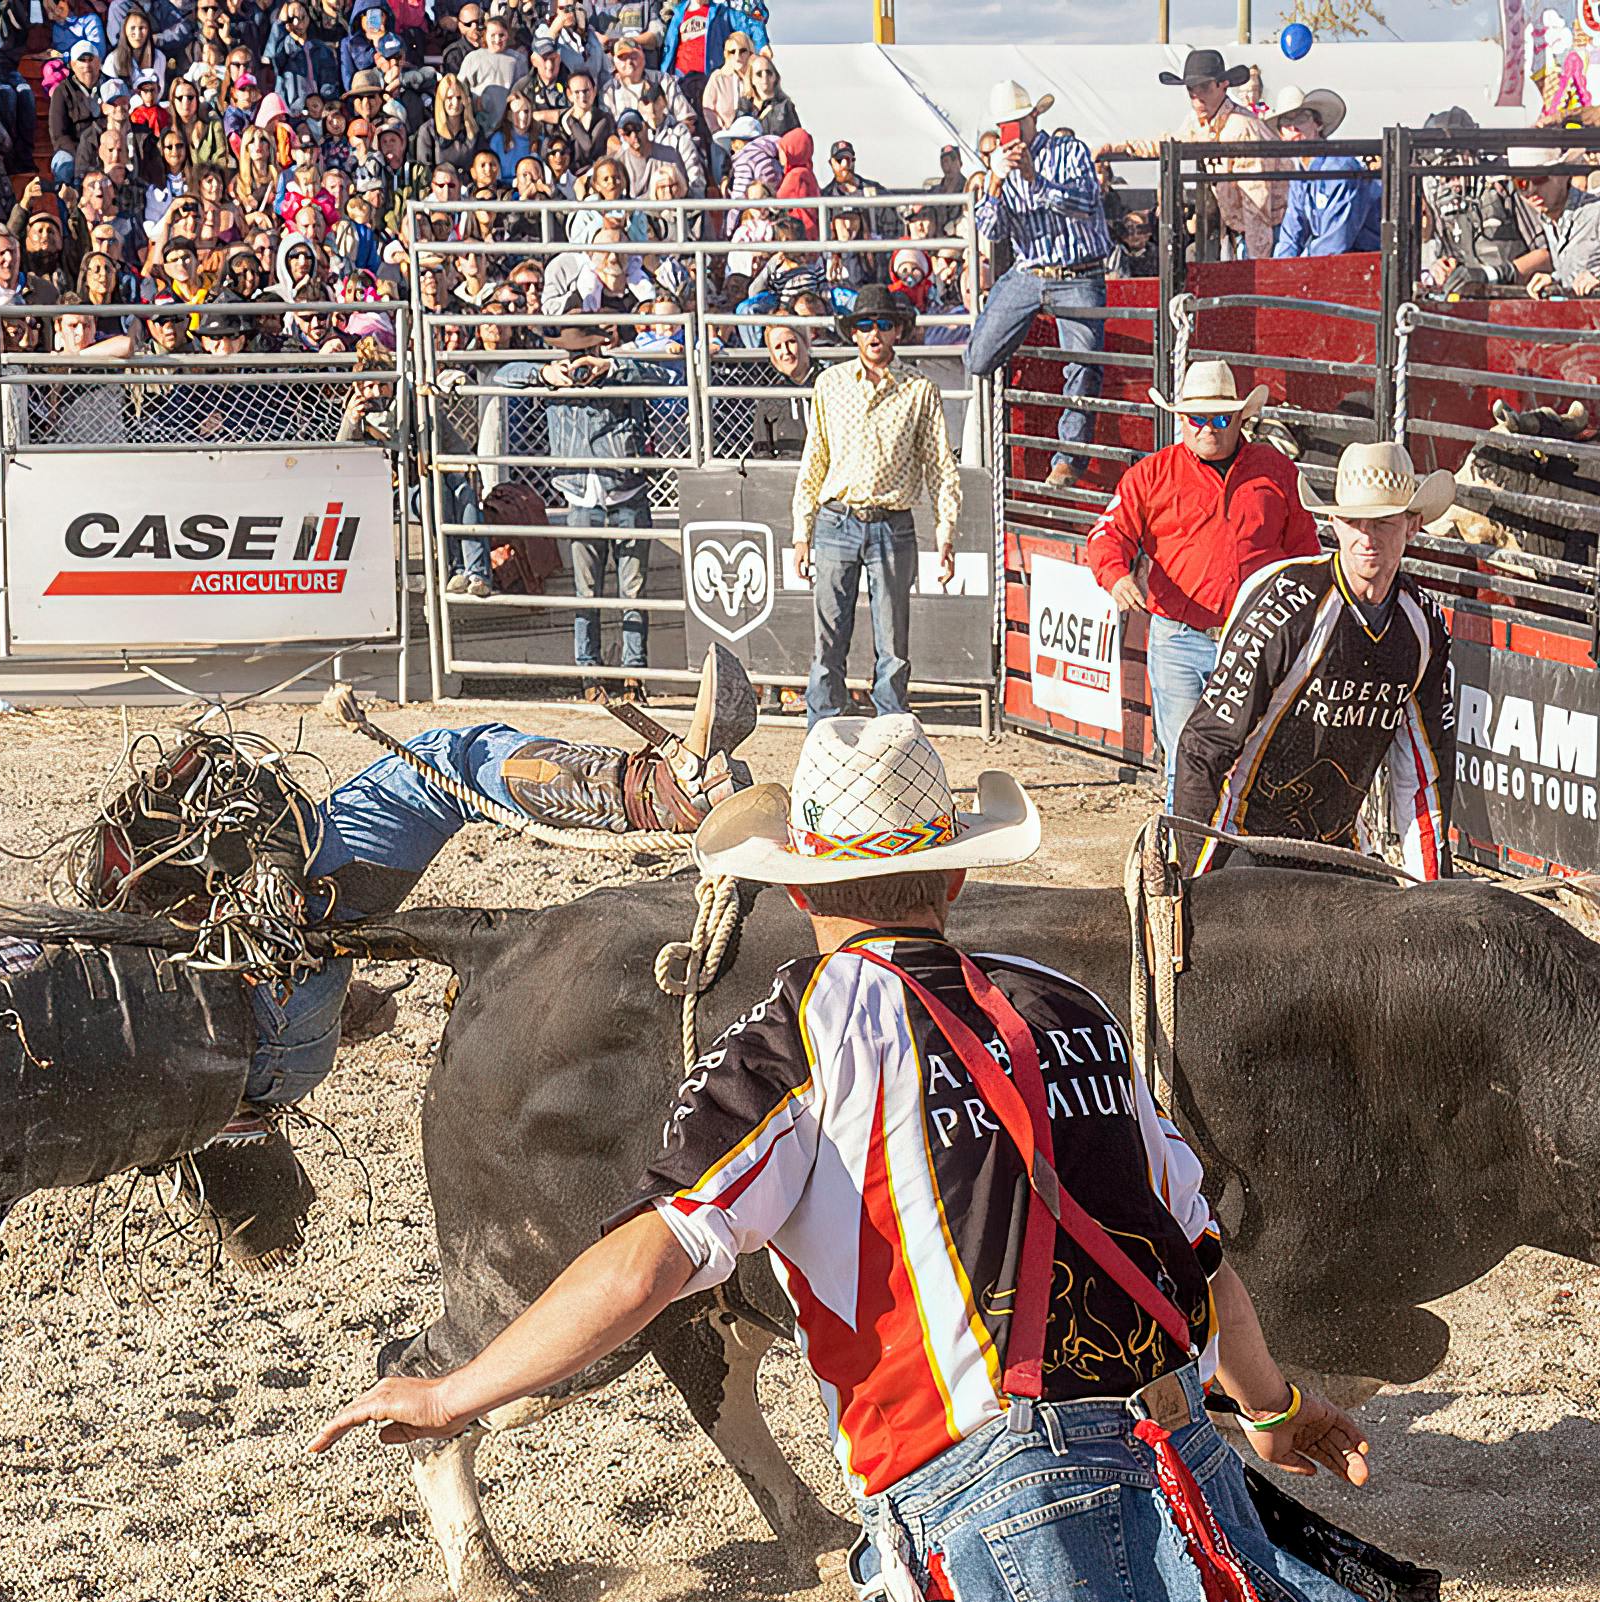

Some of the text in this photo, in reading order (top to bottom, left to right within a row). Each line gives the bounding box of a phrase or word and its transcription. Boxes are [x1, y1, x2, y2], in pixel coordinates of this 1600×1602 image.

[64, 512, 284, 560] CASE
[190, 573, 338, 592] AGRICULTURE
[1039, 606, 1094, 658] CASE
[1202, 572, 1297, 709] ALBERTA
[1215, 584, 1317, 725] PREMIUM
[1456, 684, 1599, 778] RAM
[1455, 751, 1598, 821] RODEO TOUR
[928, 1024, 1128, 1096] ABRTA
